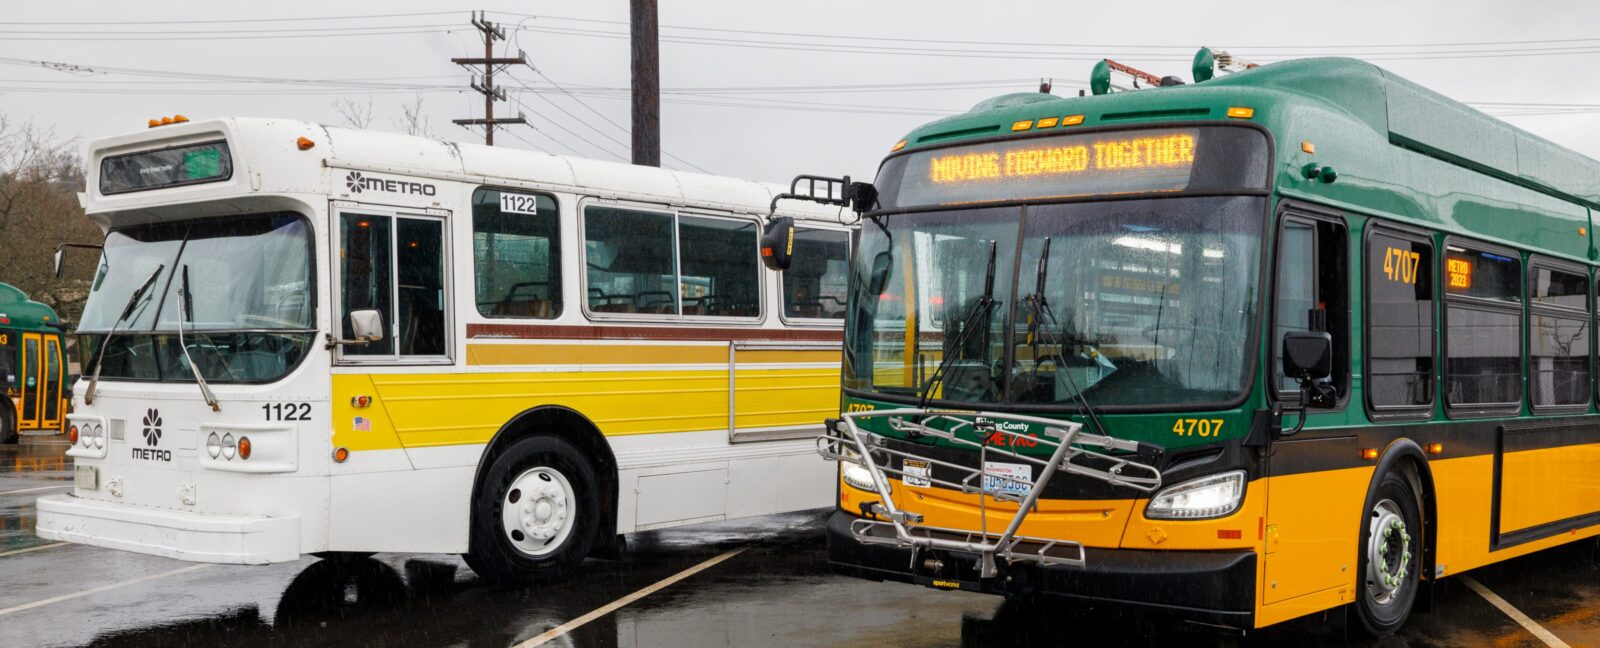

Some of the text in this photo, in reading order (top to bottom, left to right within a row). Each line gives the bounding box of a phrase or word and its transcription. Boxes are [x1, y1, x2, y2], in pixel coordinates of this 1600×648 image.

[931, 135, 1194, 182] MOVING FORWARD TOGETHER
[366, 177, 436, 197] METRO
[502, 194, 535, 213] 1122
[1383, 247, 1420, 284] 4707
[1448, 259, 1468, 274] METRO
[1450, 273, 1467, 288] 2023
[262, 402, 312, 421] 1122
[1003, 421, 1029, 432] County
[1173, 418, 1224, 437] 4707
[986, 431, 1038, 448] METRO
[132, 447, 171, 462] METRO
